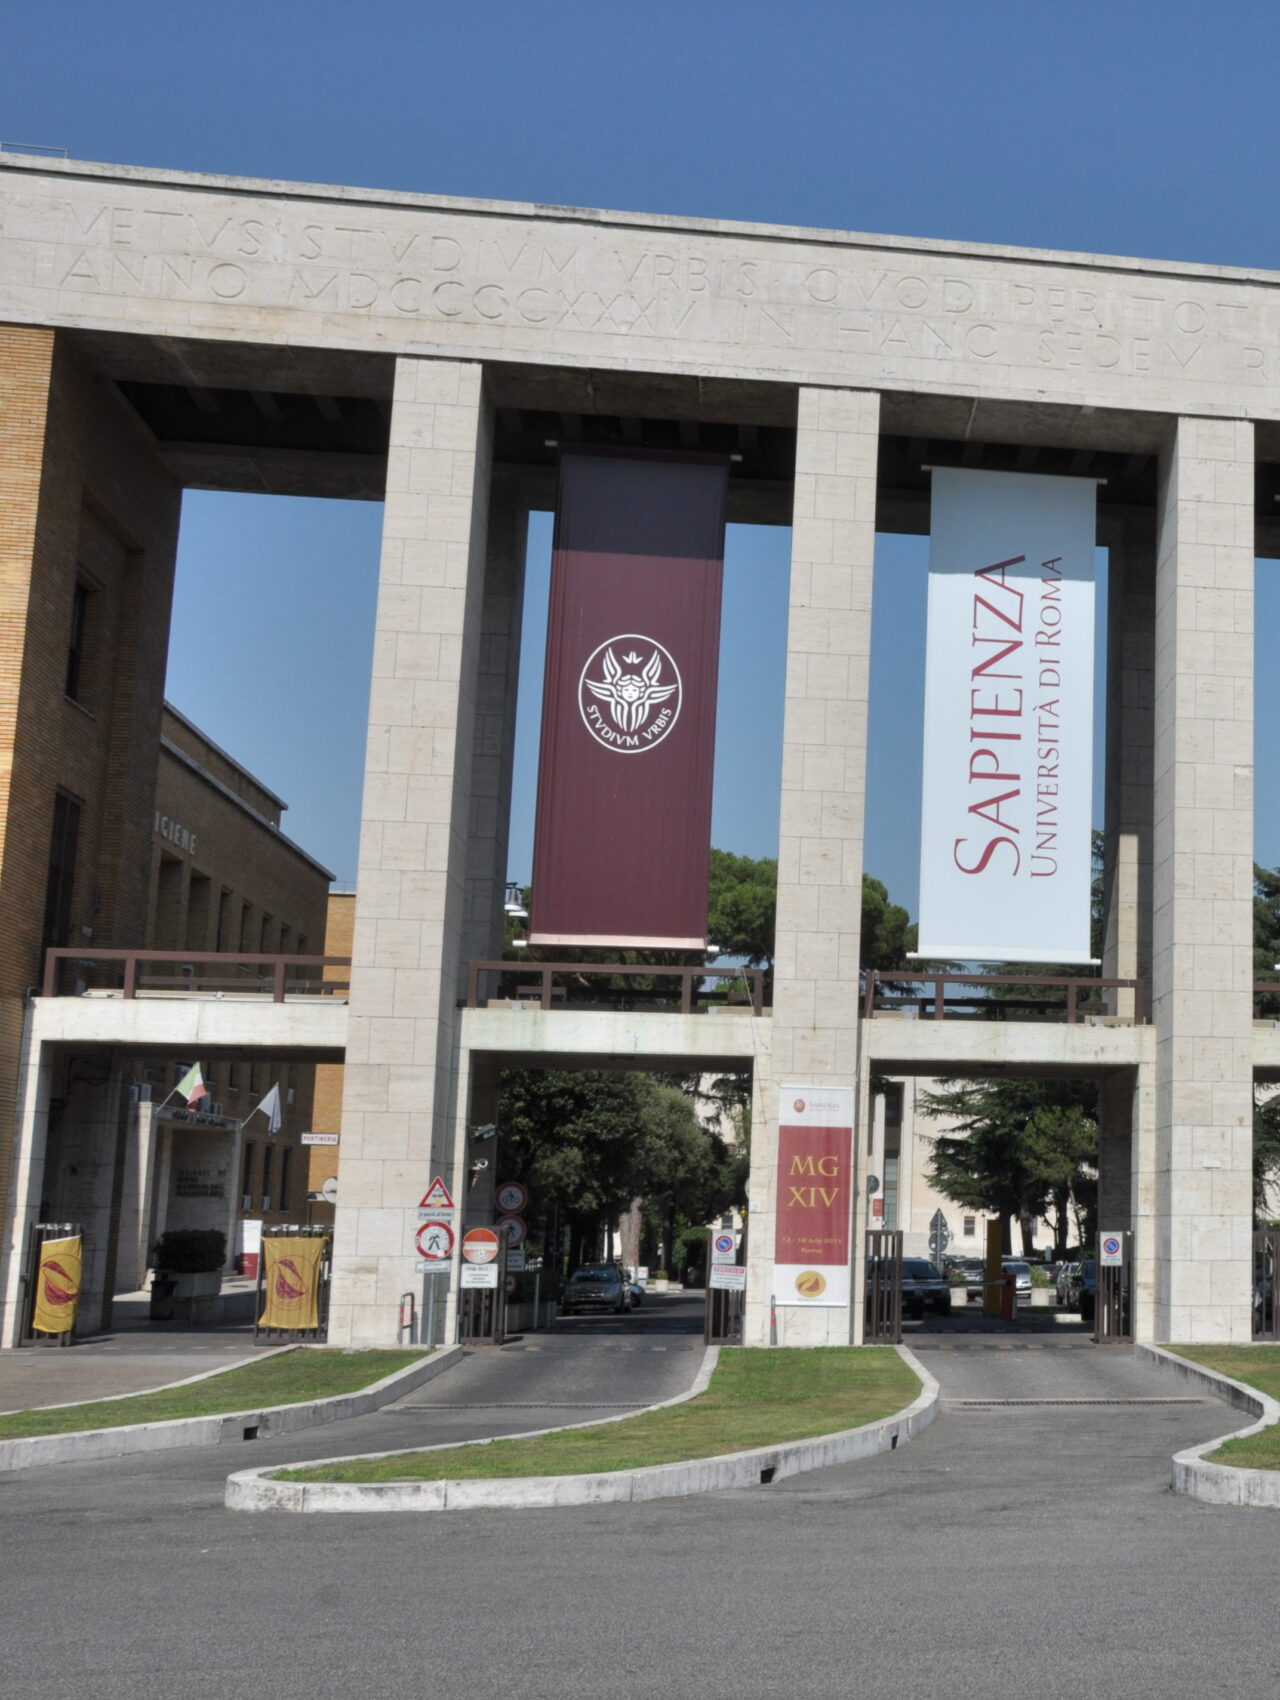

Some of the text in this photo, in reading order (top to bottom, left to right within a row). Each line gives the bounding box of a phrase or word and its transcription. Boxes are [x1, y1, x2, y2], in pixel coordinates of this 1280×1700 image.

[59, 251, 248, 299] ANNO
[287, 268, 697, 332] MDCCCCXXXV
[741, 304, 794, 342] IN
[837, 313, 1000, 359] HANC
[1037, 330, 1205, 374] SEDEM
[65, 201, 266, 258] VETVS
[299, 223, 580, 285] STVDIVM
[613, 249, 758, 299] VRBIS
[803, 268, 976, 316] QVOD
[1013, 284, 1102, 327] PER
[1131, 295, 1249, 339] TOT
[586, 704, 673, 746] STVDIVM VRBIS
[953, 554, 1027, 878] SAPIENZA
[1030, 556, 1063, 880] UNIVERSITÀ DI ROMA
[788, 1155, 840, 1177] MG
[788, 1186, 840, 1209] XIV
